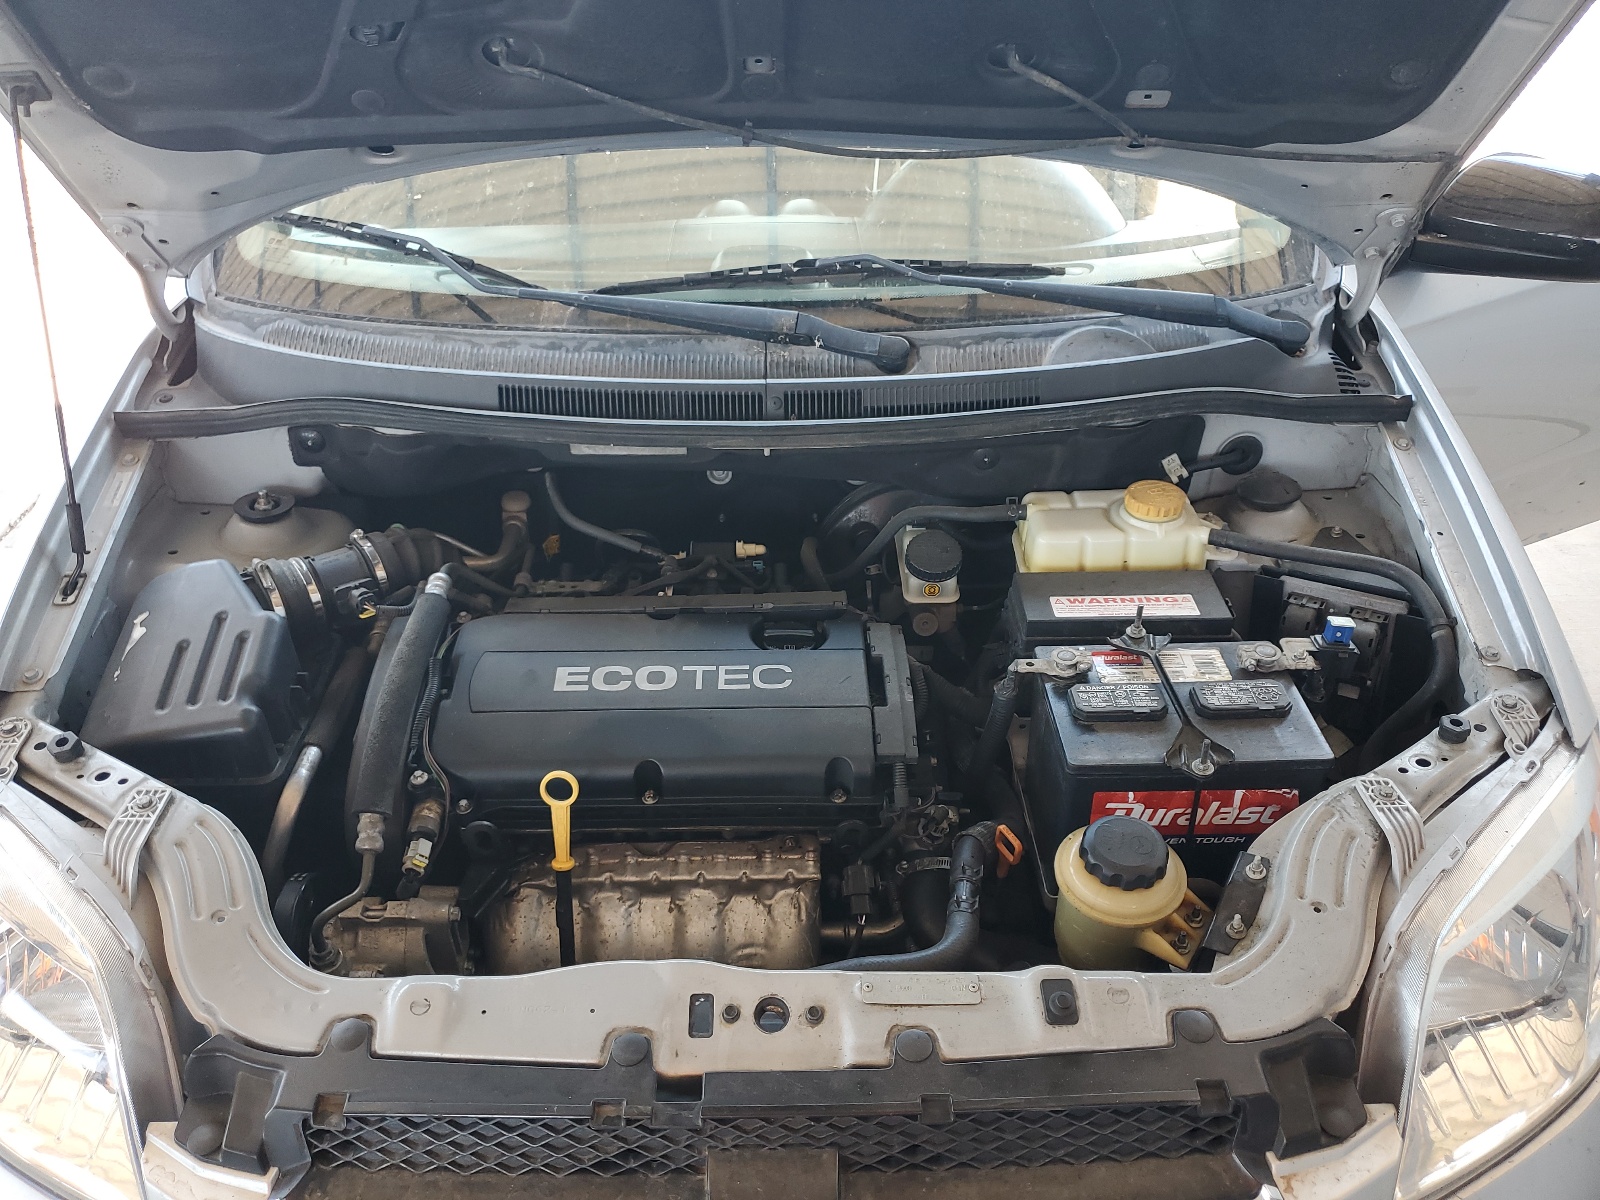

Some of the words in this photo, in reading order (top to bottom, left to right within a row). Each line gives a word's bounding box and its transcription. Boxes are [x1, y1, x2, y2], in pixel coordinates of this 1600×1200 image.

[1066, 596, 1179, 604] WARNING
[553, 665, 793, 692] ECOTEC
[1195, 836, 1246, 844] TOUGH
